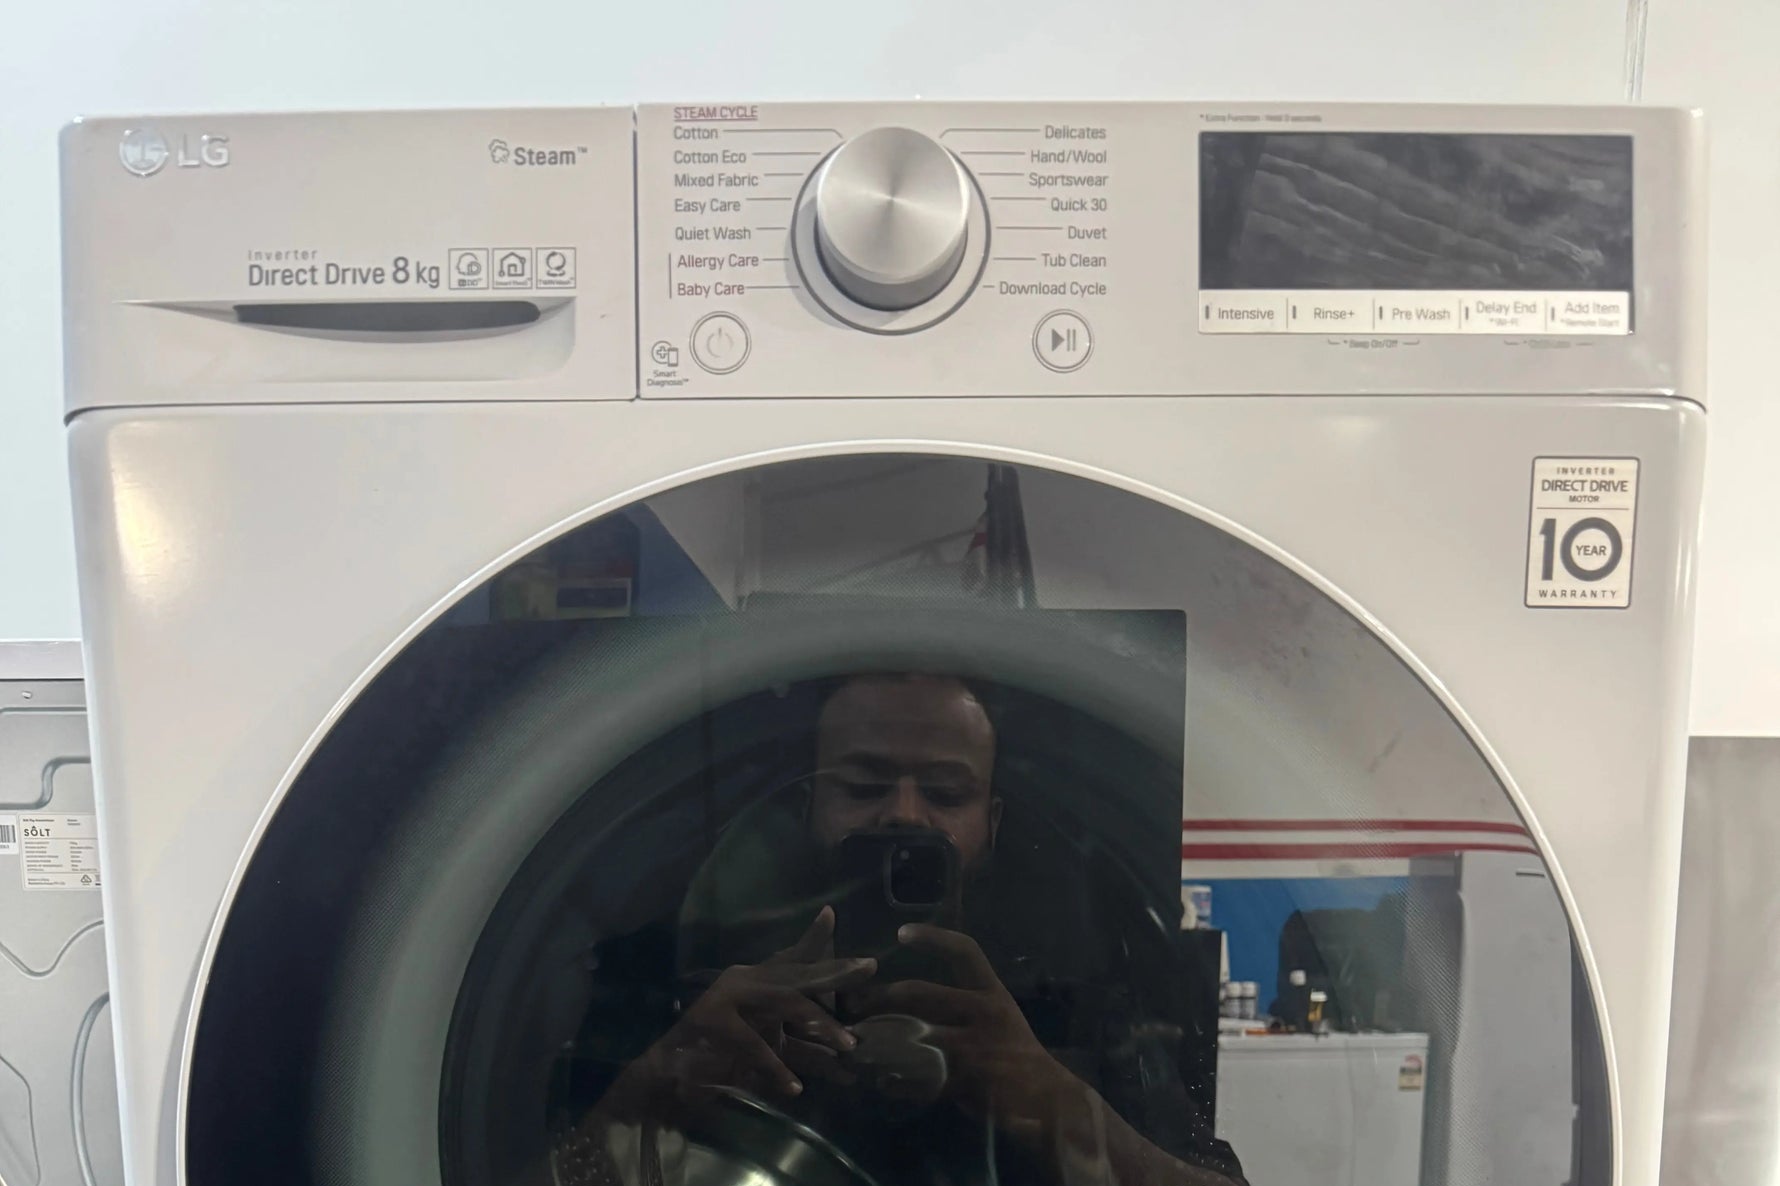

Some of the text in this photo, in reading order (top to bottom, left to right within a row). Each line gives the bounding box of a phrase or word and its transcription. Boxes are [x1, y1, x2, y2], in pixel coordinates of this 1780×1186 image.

[674, 106, 758, 119] STEAM CYCLE
[674, 126, 718, 140] Cotton
[1044, 125, 1107, 139] Delicates
[178, 135, 229, 167] LG
[674, 151, 747, 164] Cotton Eco
[1031, 150, 1107, 164] Hand/Wool
[674, 174, 759, 187] Mixed Fabric
[1029, 173, 1109, 189] Sportswear
[675, 199, 741, 214] Easy Care
[1050, 198, 1107, 212] Quick 30
[675, 227, 751, 241] Quiet Wash
[1068, 226, 1107, 239] Duvet
[677, 254, 759, 270] Allergy Care
[1042, 254, 1107, 267] Tub Clean
[249, 256, 440, 289] Direct Drive 8 kg
[677, 282, 745, 298] Baby Care
[1000, 282, 1107, 299] Download Cycle
[1218, 307, 1274, 320] Intensive
[1314, 308, 1355, 319] Rinse+
[1392, 308, 1450, 320] Pre Wash
[1476, 301, 1537, 315] Delay End
[1565, 302, 1620, 314] Add Item
[1557, 467, 1615, 475] INVERTER
[1541, 479, 1628, 492] DIRECT DRIVE
[1539, 516, 1623, 582] 10
[1576, 545, 1606, 556] YEAR
[1539, 590, 1617, 598] WARRANTY
[24, 825, 50, 836] SÔLT
